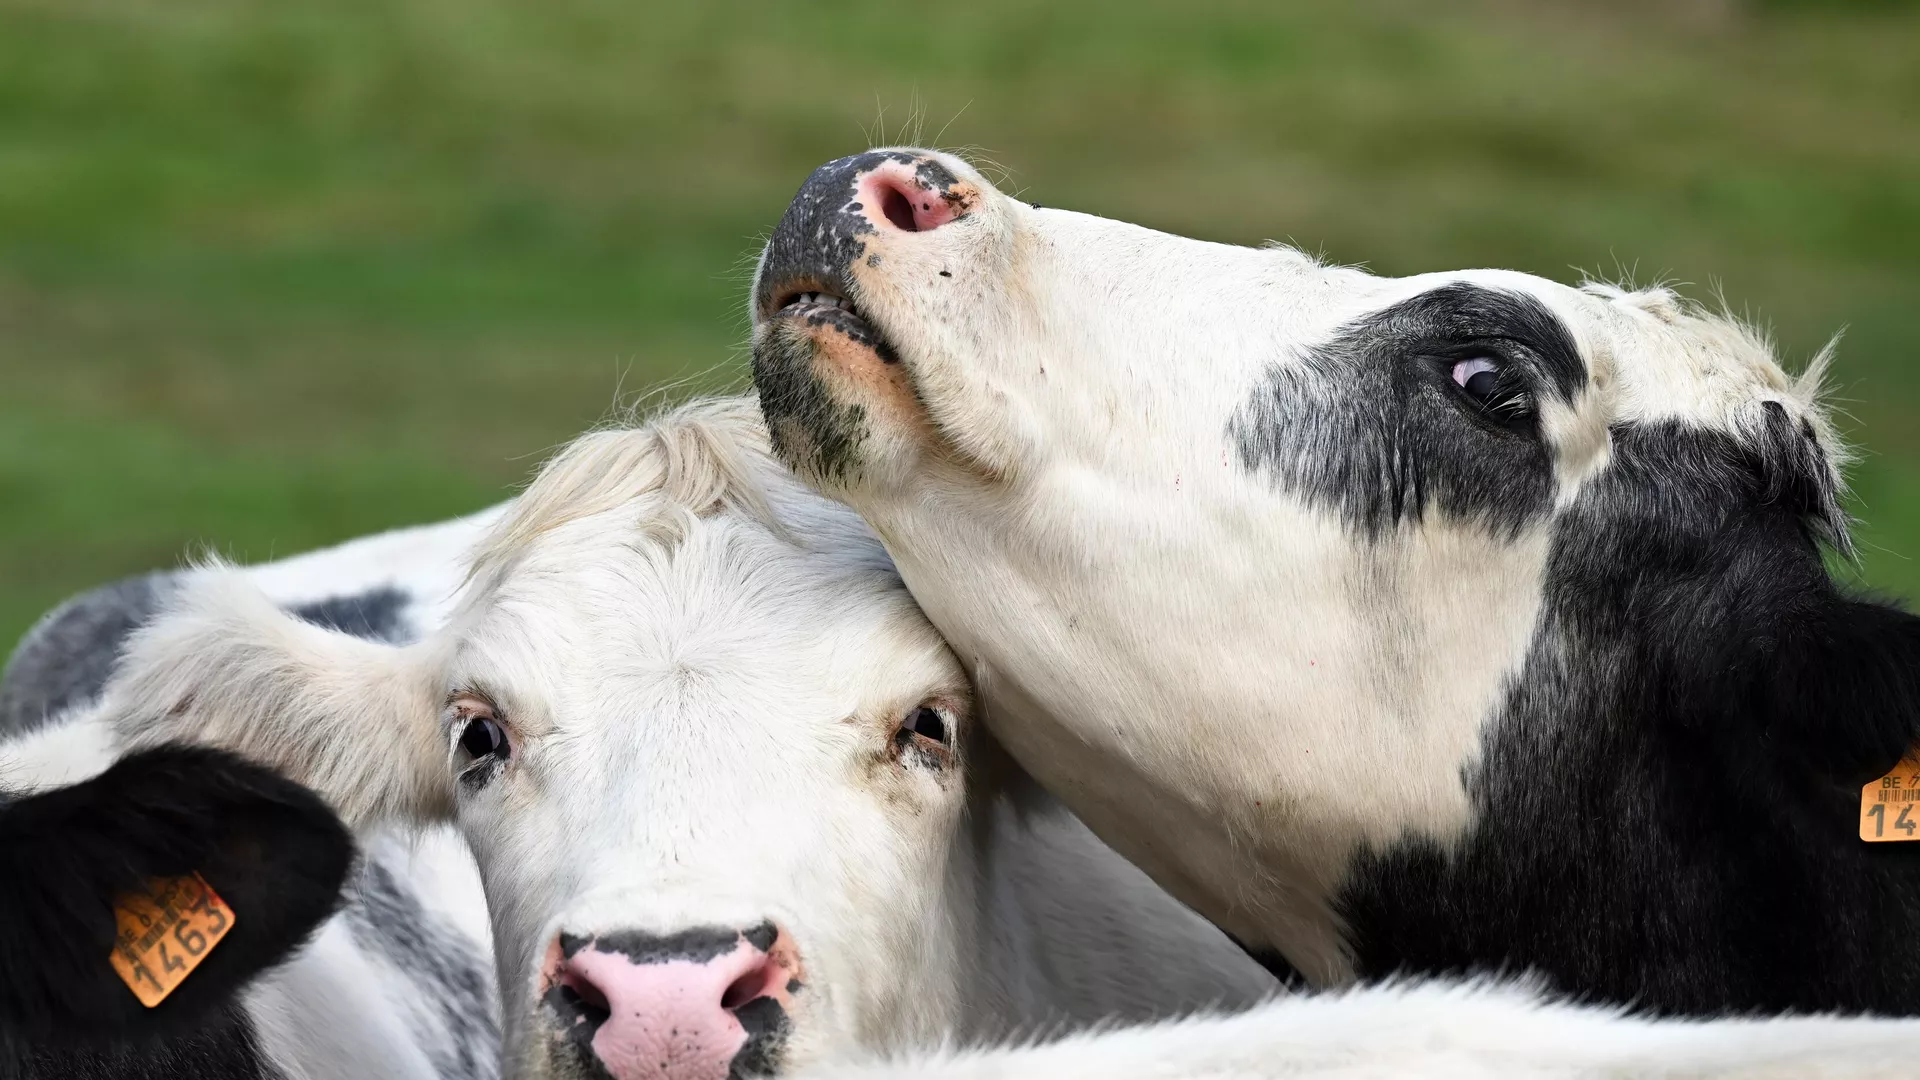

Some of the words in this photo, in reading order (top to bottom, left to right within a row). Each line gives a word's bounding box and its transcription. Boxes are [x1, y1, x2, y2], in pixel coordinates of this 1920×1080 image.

[1882, 776, 1901, 789] BE
[1866, 803, 1917, 838] 14
[133, 895, 227, 993] 1463
